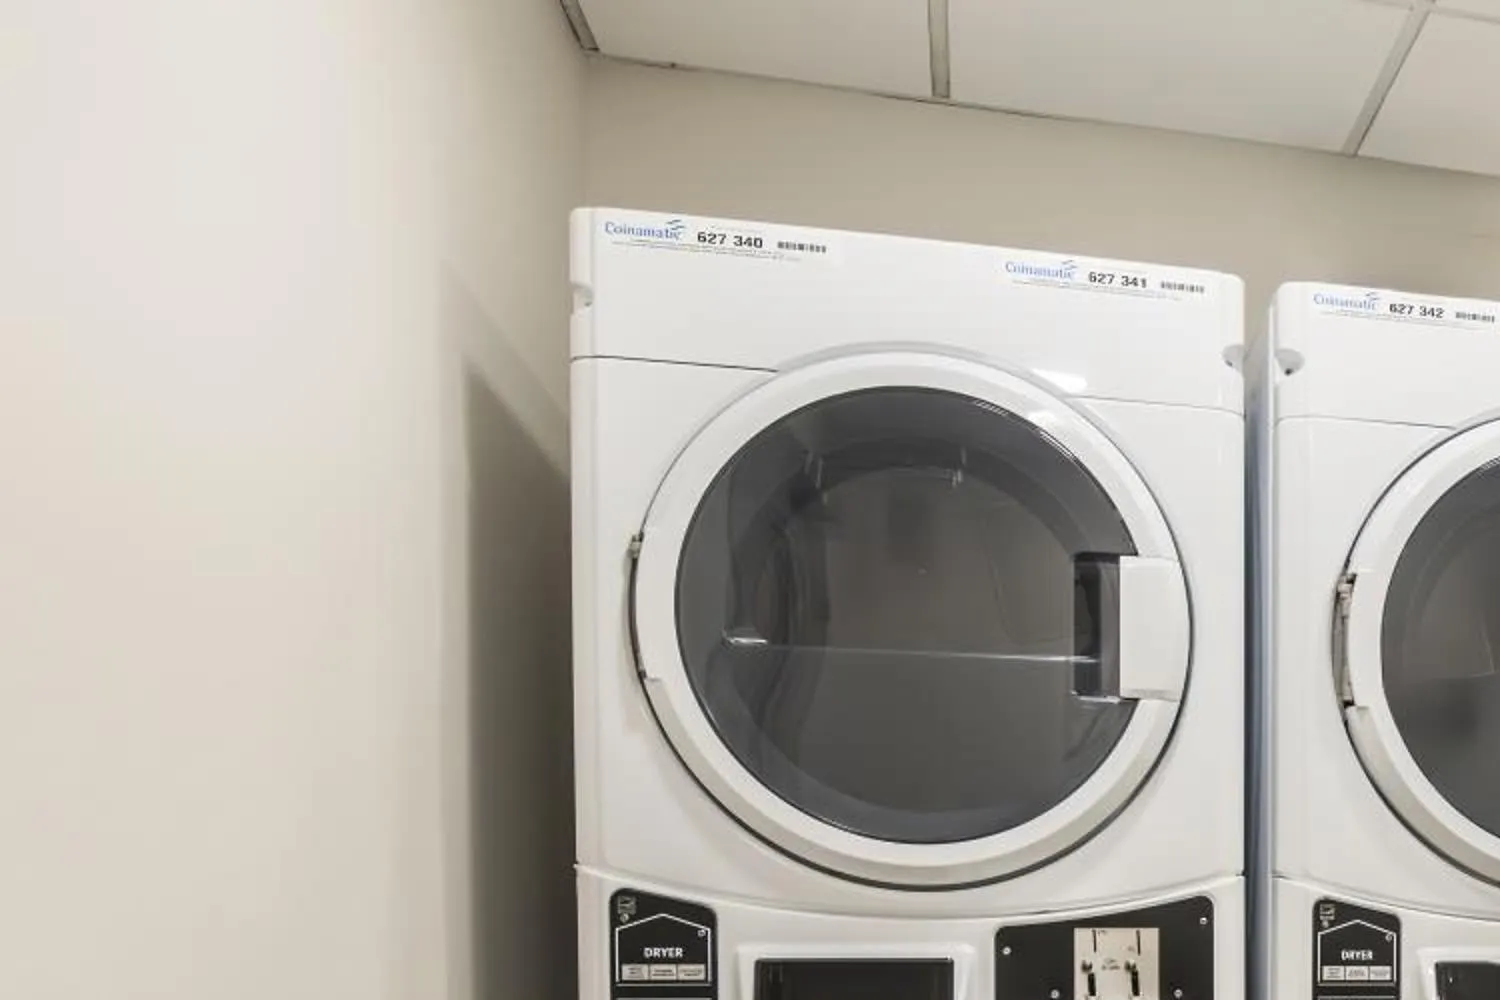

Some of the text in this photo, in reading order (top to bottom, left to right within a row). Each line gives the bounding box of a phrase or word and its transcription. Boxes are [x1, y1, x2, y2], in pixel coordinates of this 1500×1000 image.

[697, 231, 763, 249] 627 340
[1088, 272, 1147, 288] 627 341
[1389, 303, 1445, 318] 627 342
[643, 946, 684, 959] DRYER
[1341, 949, 1373, 961] DRYER
